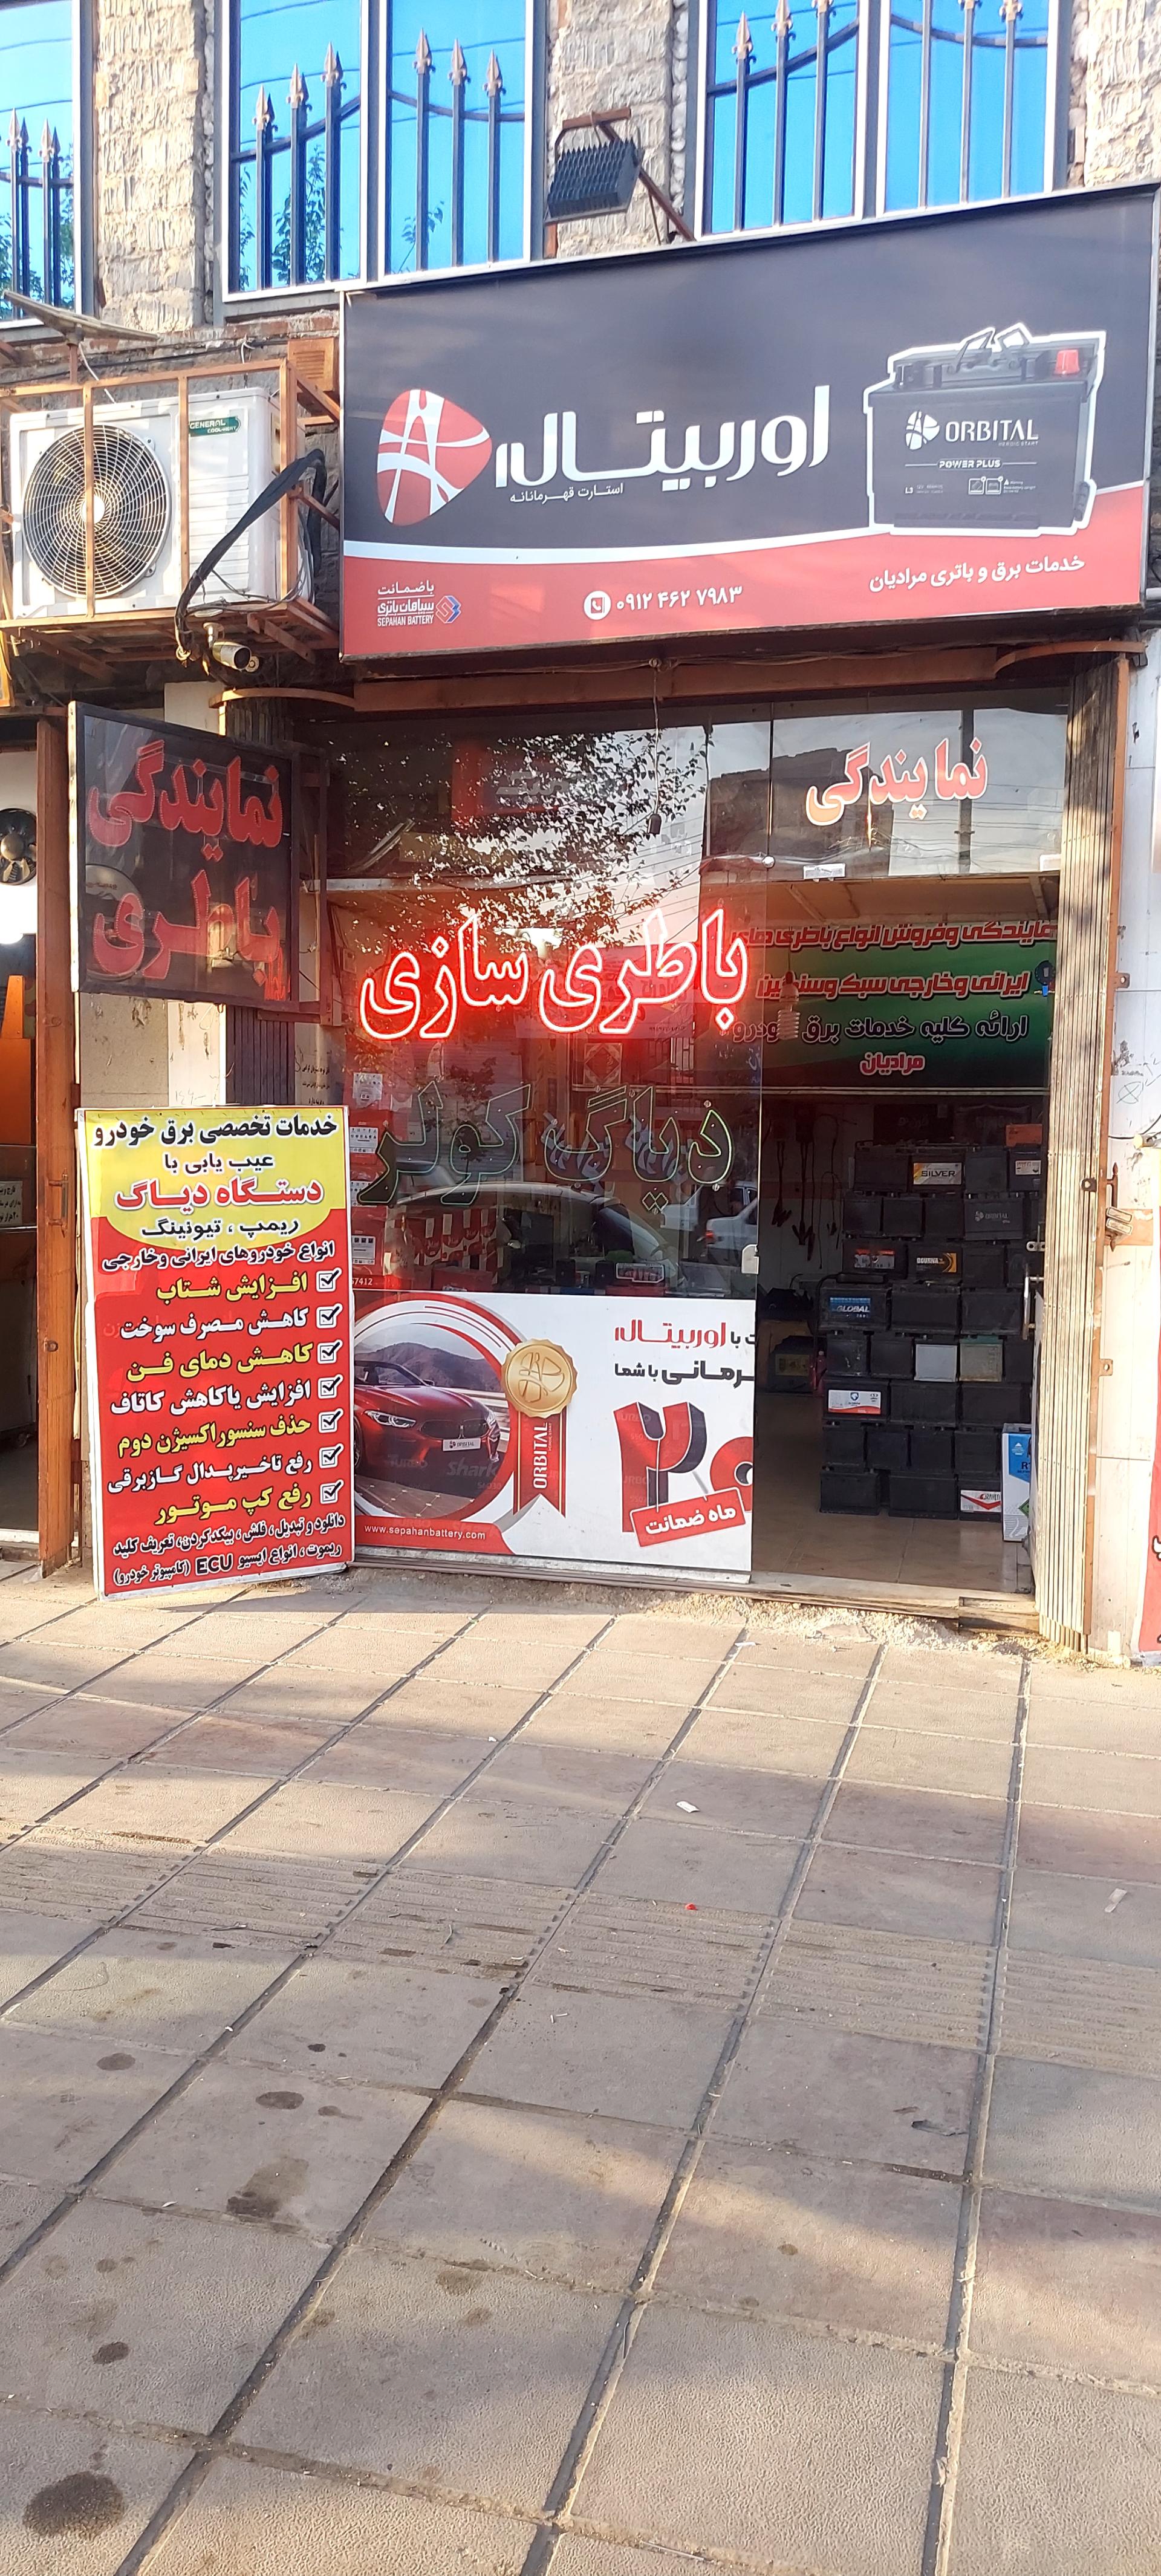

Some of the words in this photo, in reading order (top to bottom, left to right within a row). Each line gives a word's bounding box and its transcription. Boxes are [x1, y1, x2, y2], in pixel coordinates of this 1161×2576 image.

[189, 419, 226, 429] GENERAL
[945, 419, 1039, 443] ORBITAL
[496, 385, 830, 492] اوربیتال
[938, 460, 975, 469] POWER
[976, 459, 1001, 469] PLUS
[510, 486, 574, 504] قهرمانانه
[577, 483, 624, 501] استارت
[930, 562, 974, 587] باتری
[977, 566, 988, 584] و
[991, 561, 1022, 582] برق
[1025, 555, 1085, 574] خدمات
[869, 568, 928, 592] مرادیان
[377, 600, 398, 617] باتری
[399, 598, 435, 614] سپاهان
[616, 593, 652, 611] ۰۹۱۲
[657, 590, 691, 608] ۴۶۲
[696, 585, 743, 606] ۷۹۸۳
[377, 615, 406, 627] SEPAHAN
[407, 614, 434, 625] BATTERY
[806, 737, 989, 826] نمایندگی
[87, 739, 283, 862] نمایندگی
[93, 870, 281, 987] باطری
[775, 926, 833, 951] باطری
[833, 925, 880, 950] انواع
[961, 920, 1058, 945] مایندگی
[360, 912, 528, 1040] سازی
[538, 907, 748, 1034] باطری
[756, 972, 839, 1000] وسنین
[839, 972, 888, 999] سبک
[969, 971, 1030, 998] ایرانی
[732, 1021, 781, 1043] ودرو
[801, 1015, 841, 1045] برق
[844, 1015, 915, 1038] خدمات
[920, 1016, 970, 1044] کلیه
[975, 1009, 1028, 1042] ارائه
[859, 1051, 926, 1076] مرادیان
[93, 1116, 155, 1147] خودرو
[160, 1119, 194, 1145] برق
[200, 1115, 272, 1144] تخصصی
[276, 1114, 338, 1137] خدمات
[356, 1079, 532, 1206] کولر
[544, 1084, 733, 1213] دیاگ
[164, 1154, 178, 1174] با
[184, 1153, 222, 1174] یابی
[228, 1154, 274, 1172] عیب
[115, 1179, 209, 1214] دیاگ
[216, 1177, 323, 1206] دستگاه
[141, 1218, 221, 1240] تیونینگ
[239, 1220, 299, 1238] ریمپ
[170, 1248, 216, 1267] ایرانی
[220, 1243, 294, 1266] خودروهای
[297, 1241, 334, 1263] انواع
[156, 1277, 221, 1306] شتاب
[226, 1272, 307, 1302] افزایش
[120, 1316, 175, 1343] سوخت
[180, 1312, 243, 1340] مصرف
[247, 1307, 310, 1335] کاهش
[614, 1319, 726, 1350] اوربیتال
[730, 1331, 741, 1348] با
[126, 1351, 174, 1382] فن
[179, 1350, 232, 1378] دمای
[236, 1342, 313, 1373] کاهش
[614, 1362, 645, 1377] شما
[648, 1364, 659, 1382] با
[110, 1390, 164, 1415] کاتاف
[246, 1379, 311, 1409] افزایش
[269, 1414, 311, 1436] حذف
[118, 1431, 152, 1458] دوم
[533, 1422, 548, 1489] ORBITAL
[285, 1451, 313, 1475] رفع
[241, 1487, 274, 1516] کپ
[277, 1482, 313, 1510] رفع
[154, 1495, 238, 1526] موتور
[314, 1513, 345, 1532] دانلود
[645, 1508, 706, 1535] ضمانت
[707, 1503, 737, 1522] ماه
[243, 1523, 267, 1542] فلش
[275, 1518, 304, 1538] تبدیل
[306, 1522, 313, 1535] و
[364, 1525, 486, 1541] www.sepahanbattery.com
[114, 1538, 138, 1558] کلید
[141, 1534, 174, 1553] تعریف
[270, 1544, 297, 1564] انواع
[307, 1543, 341, 1558] ریموت
[196, 1554, 232, 1574] ECU
[239, 1549, 267, 1569] ایسیو
